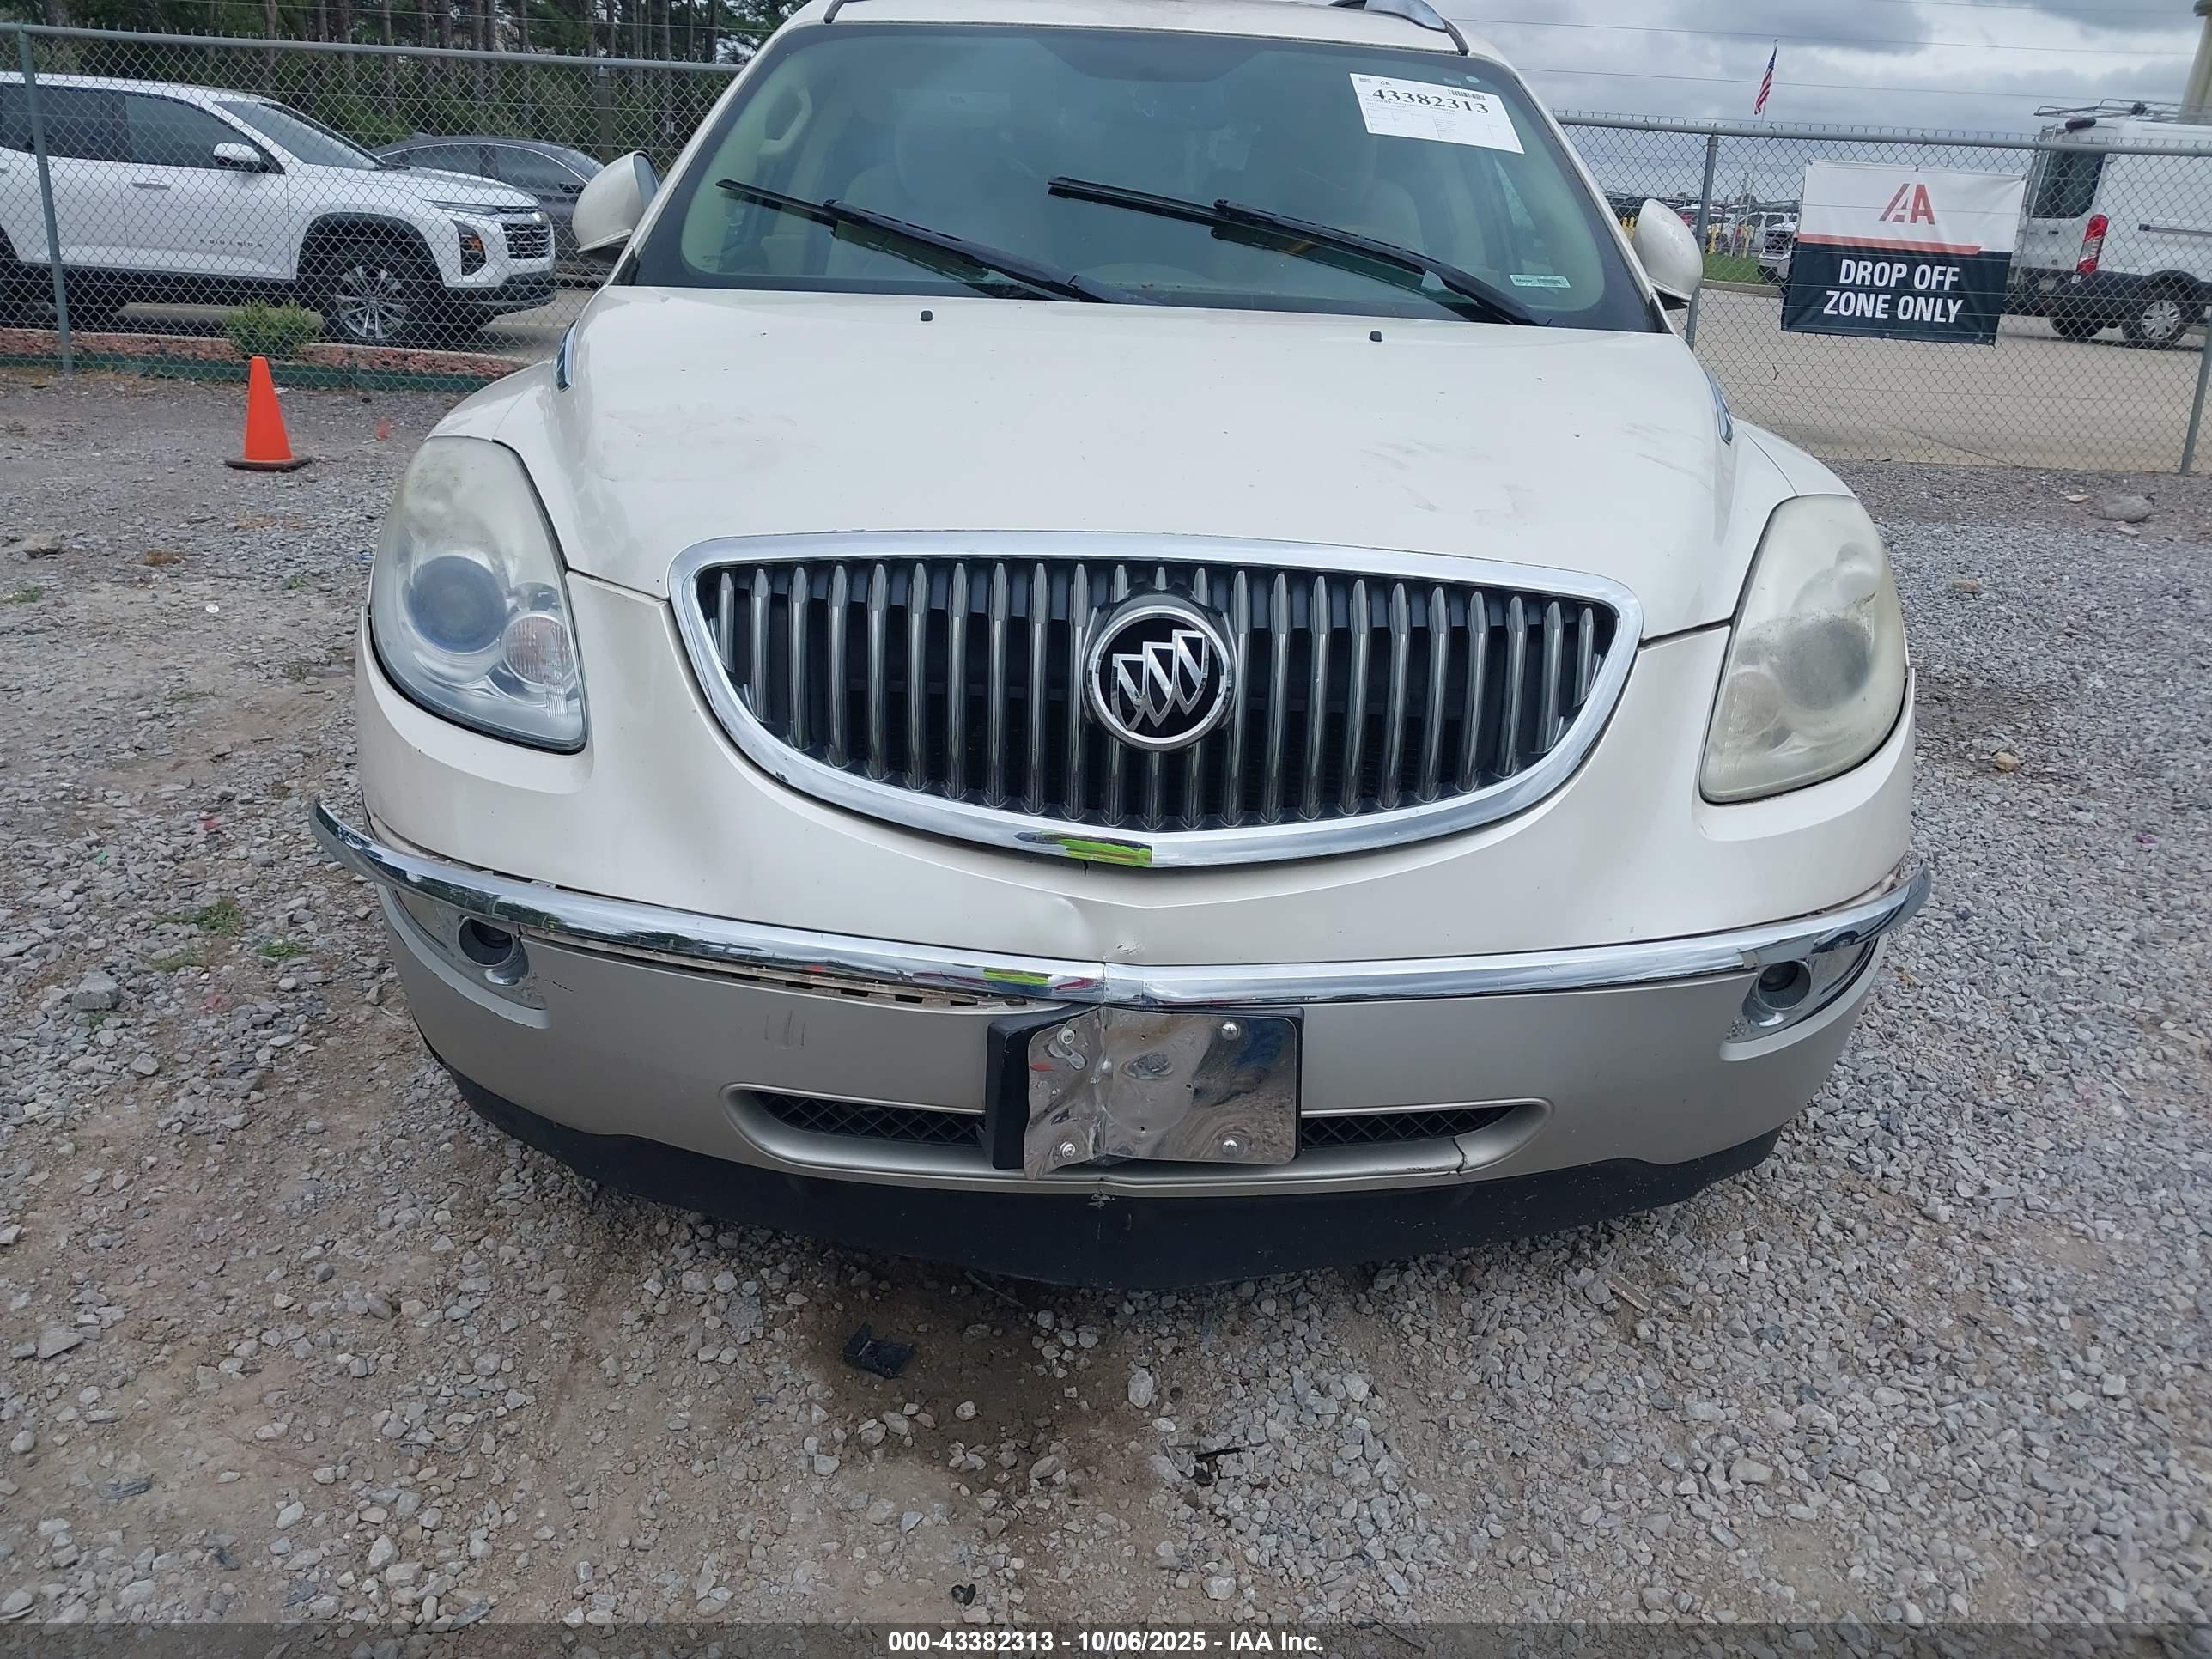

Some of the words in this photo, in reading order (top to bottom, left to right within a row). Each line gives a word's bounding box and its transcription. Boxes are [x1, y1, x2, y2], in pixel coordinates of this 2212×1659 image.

[1372, 88, 1489, 114] 43382313
[1838, 258, 1908, 288] DROP
[1913, 264, 1960, 291] OFF
[1823, 290, 1892, 319] ZONE
[1897, 295, 1965, 324] ONLY
